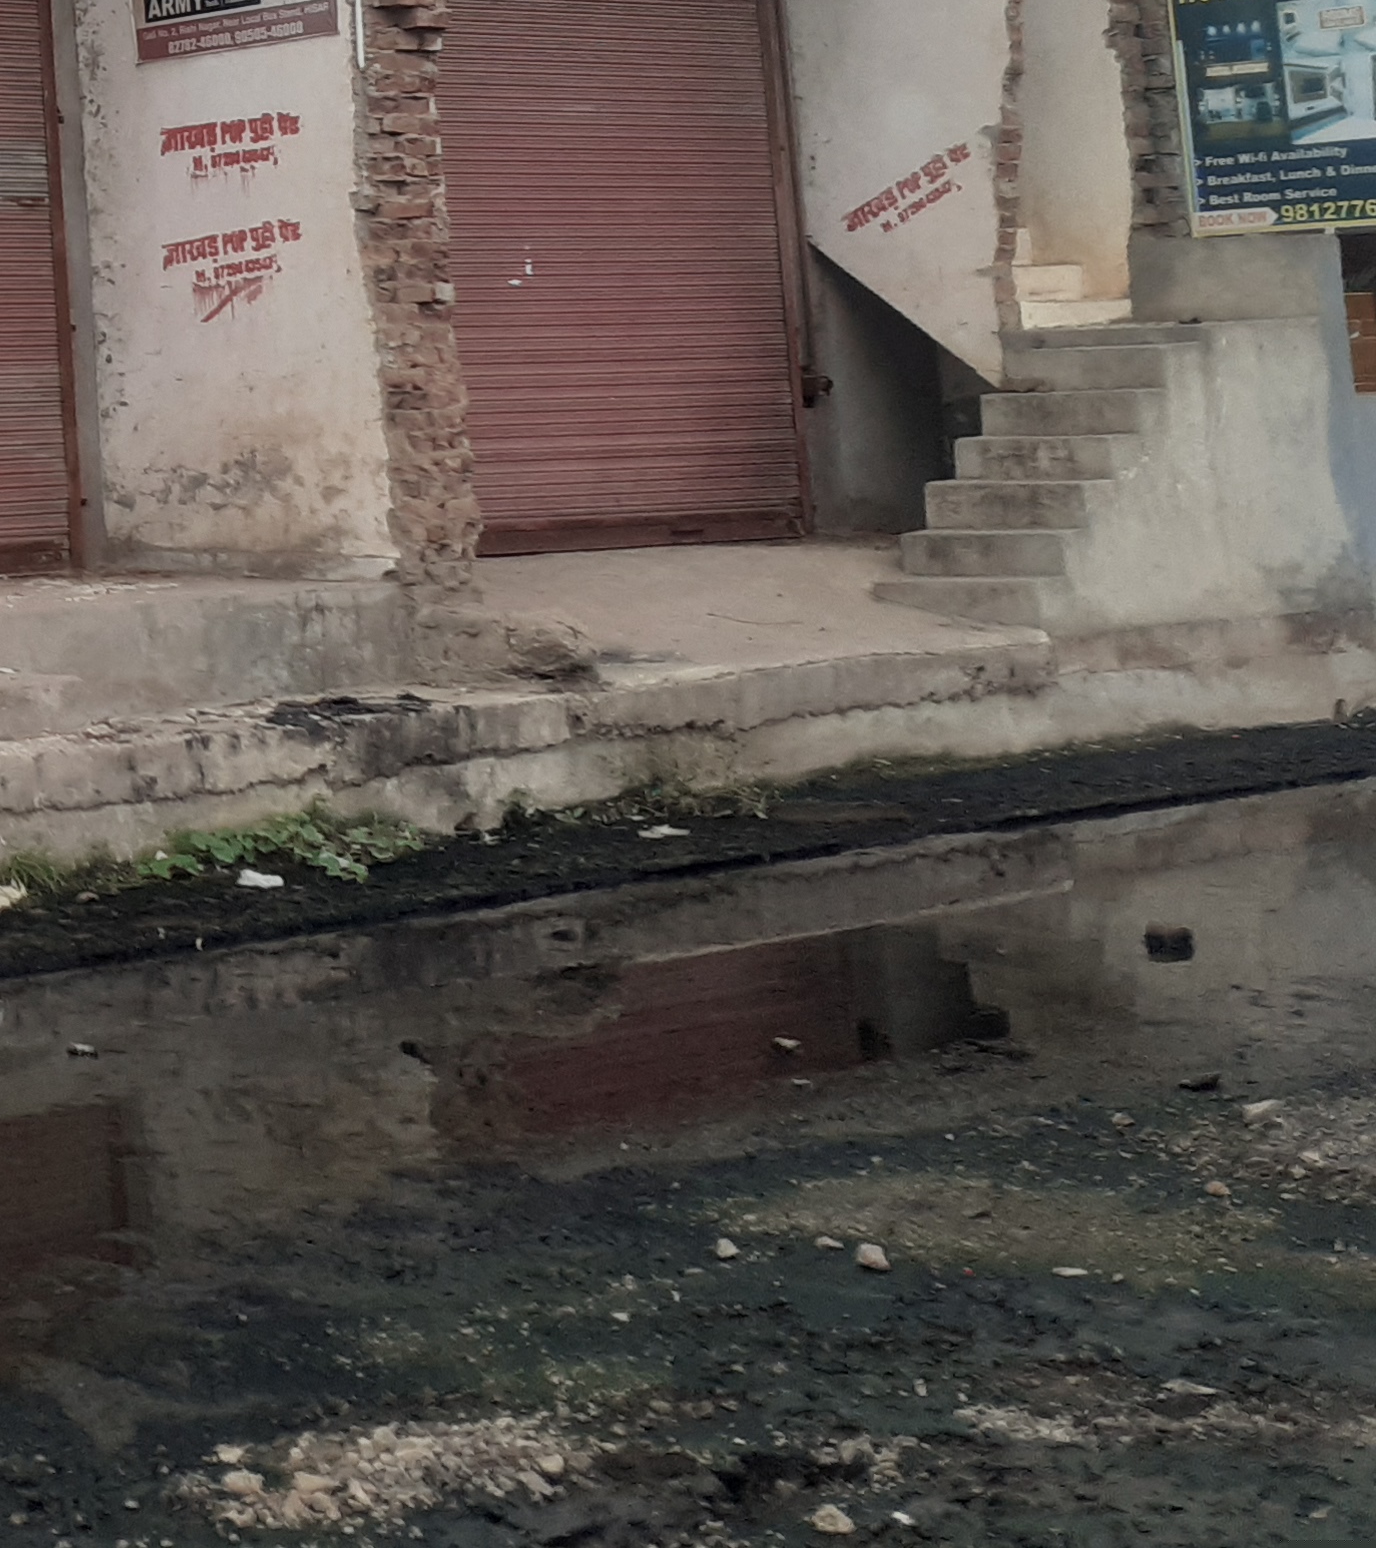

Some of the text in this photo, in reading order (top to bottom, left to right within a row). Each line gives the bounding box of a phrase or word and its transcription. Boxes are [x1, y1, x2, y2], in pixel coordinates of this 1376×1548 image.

[1204, 155, 1235, 167] Free
[1270, 145, 1348, 162] Availability
[1207, 172, 1276, 187] Breakfast,
[1280, 166, 1321, 181] Lunch
[1325, 165, 1337, 177] &
[1209, 186, 1338, 206] Best Room Service
[1199, 199, 1376, 228] BOOK NOW 9812776
